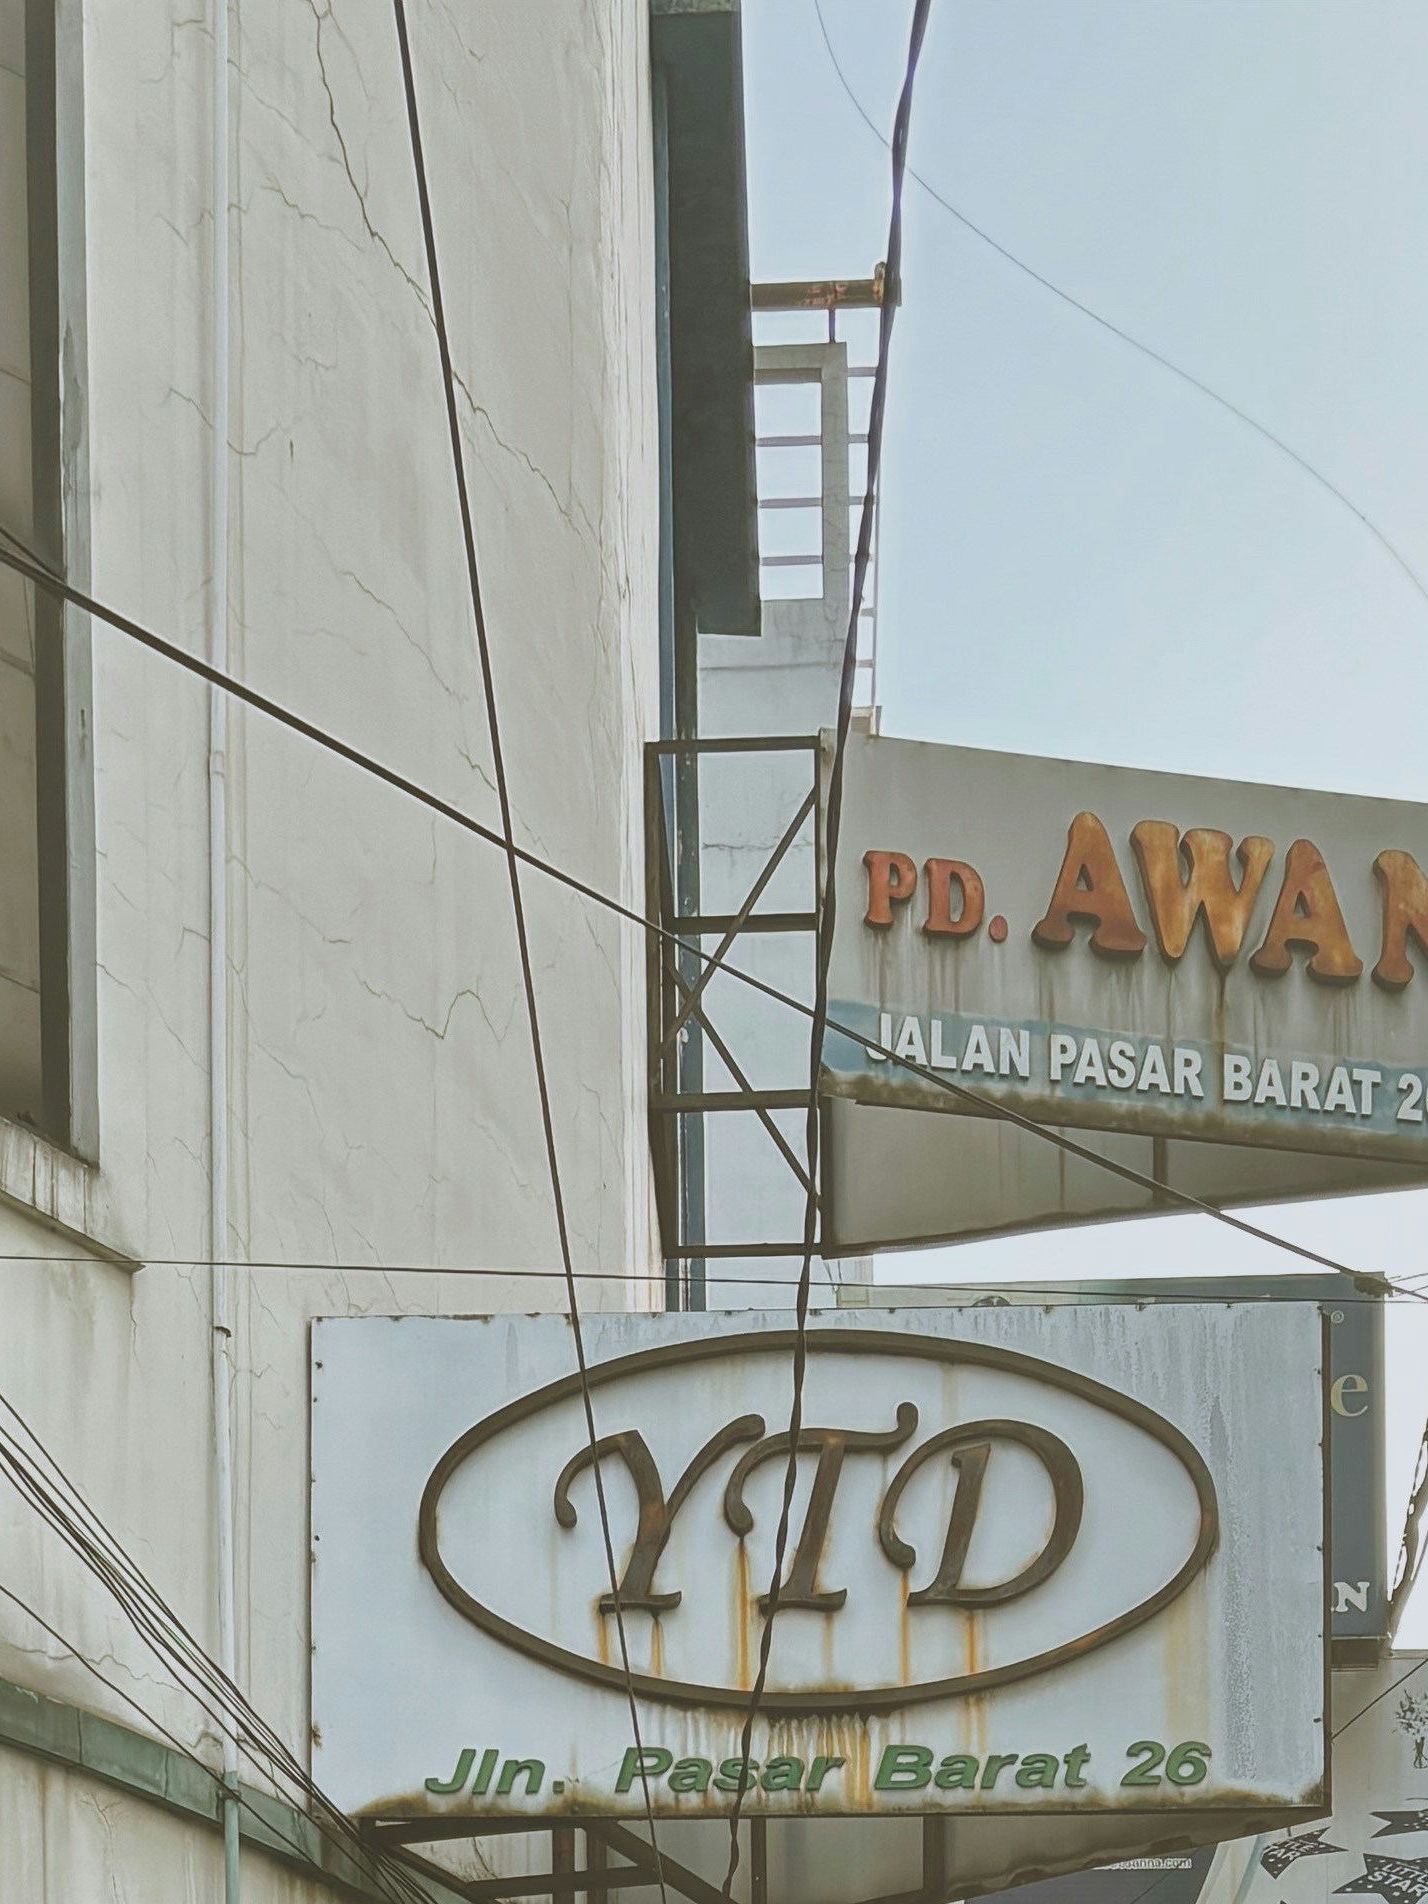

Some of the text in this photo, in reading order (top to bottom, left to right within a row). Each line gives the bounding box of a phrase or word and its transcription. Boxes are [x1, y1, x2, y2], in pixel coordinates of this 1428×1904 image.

[863, 850, 1009, 943] PD.
[864, 1012, 1030, 1077] JALAN
[1050, 1033, 1204, 1097] PASAR
[1223, 1054, 1381, 1116] BARAT
[554, 1401, 1086, 1614] YTD
[615, 1746, 845, 1795] Pasar
[874, 1742, 1090, 1793] Barat
[1121, 1740, 1213, 1787] 26
[1368, 1871, 1428, 1897] STAR
